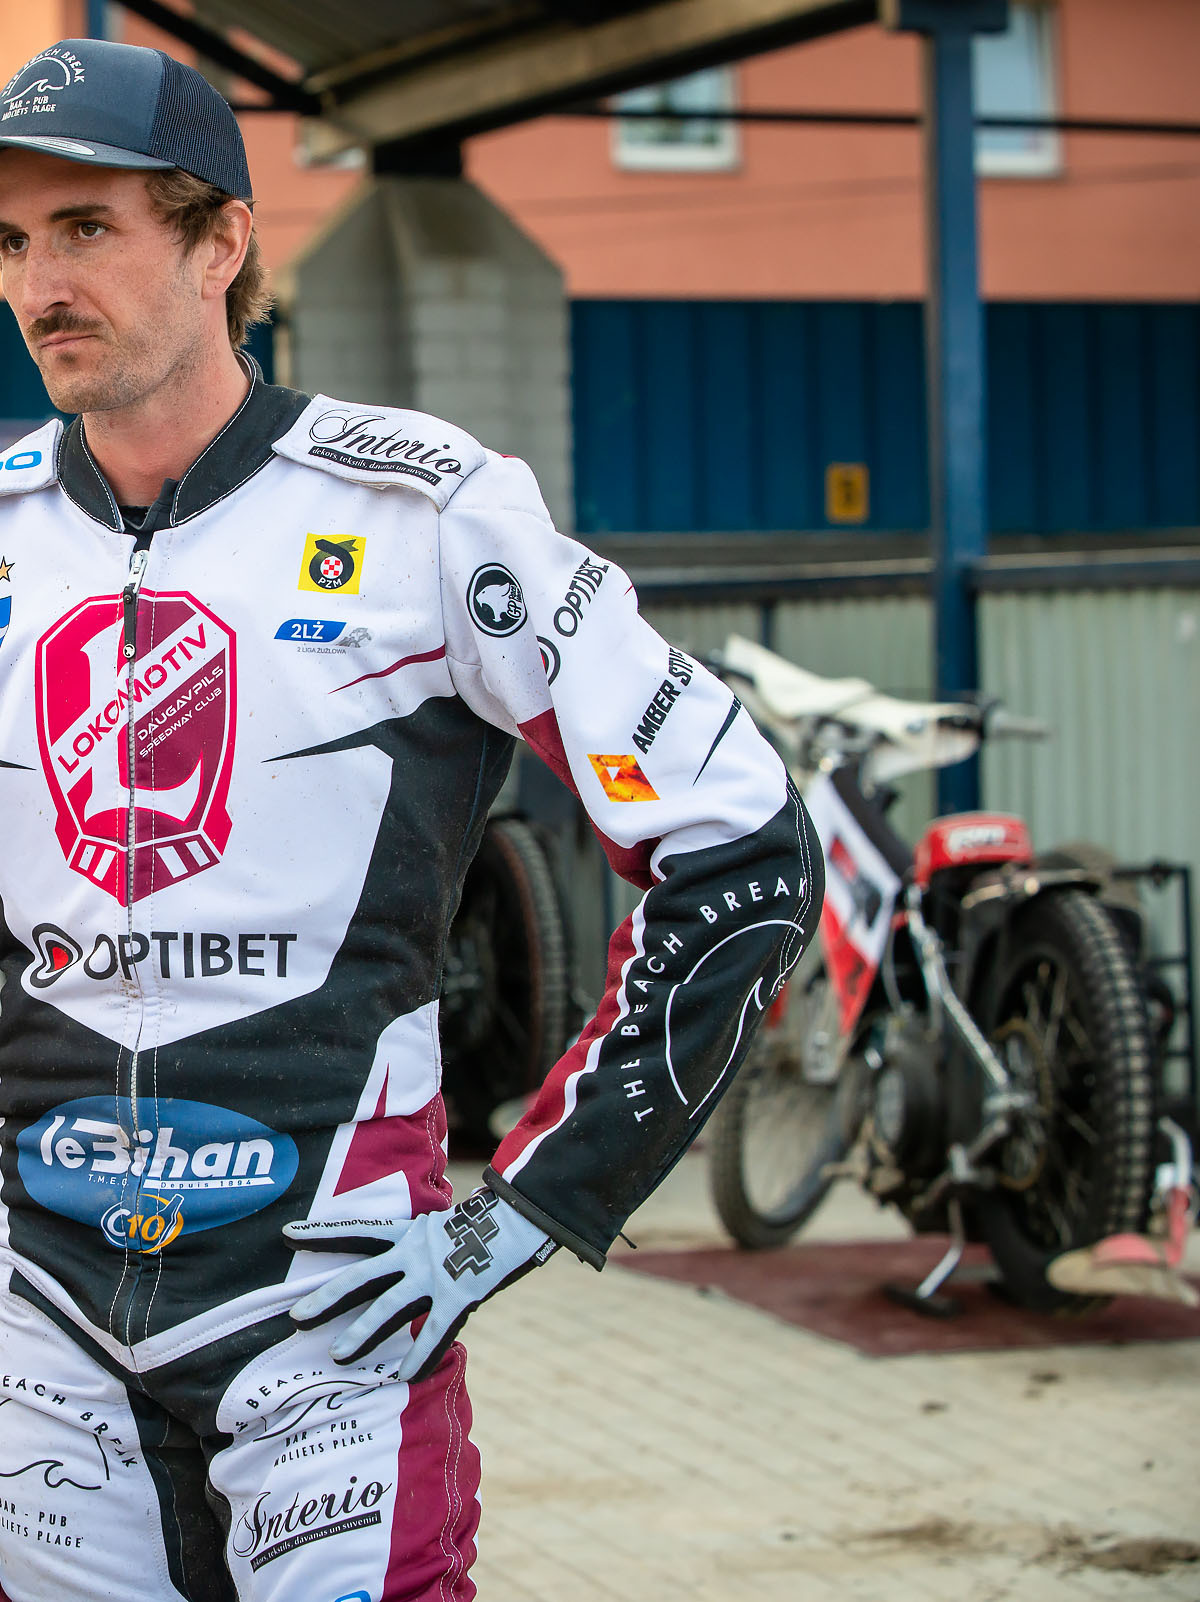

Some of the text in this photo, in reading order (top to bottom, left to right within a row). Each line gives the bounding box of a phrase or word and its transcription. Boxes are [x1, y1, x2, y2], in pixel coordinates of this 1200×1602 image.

[60, 51, 86, 83] BREAK
[32, 104, 57, 113] PLAGE
[33, 95, 49, 105] PUB
[308, 409, 465, 479] Interio
[317, 577, 343, 589] PZM
[290, 621, 325, 640] 2LŻ
[57, 622, 207, 774] LOKOMOTIV
[137, 665, 224, 741] DAUGAVPILS
[139, 687, 223, 759] SPEEDWAY CLUB
[631, 679, 682, 755] AMBER
[83, 931, 298, 980] OPTIBET
[620, 876, 807, 1123] THE BEACH BREAK
[160, 1179, 252, 1189] Depuis 1894
[285, 1431, 308, 1448] BAR
[330, 1419, 358, 1433] PUB
[333, 1432, 374, 1450] PLAGE
[38, 1511, 68, 1527] PUB
[232, 1475, 393, 1558] Interio
[37, 1531, 84, 1549] PLAGE
